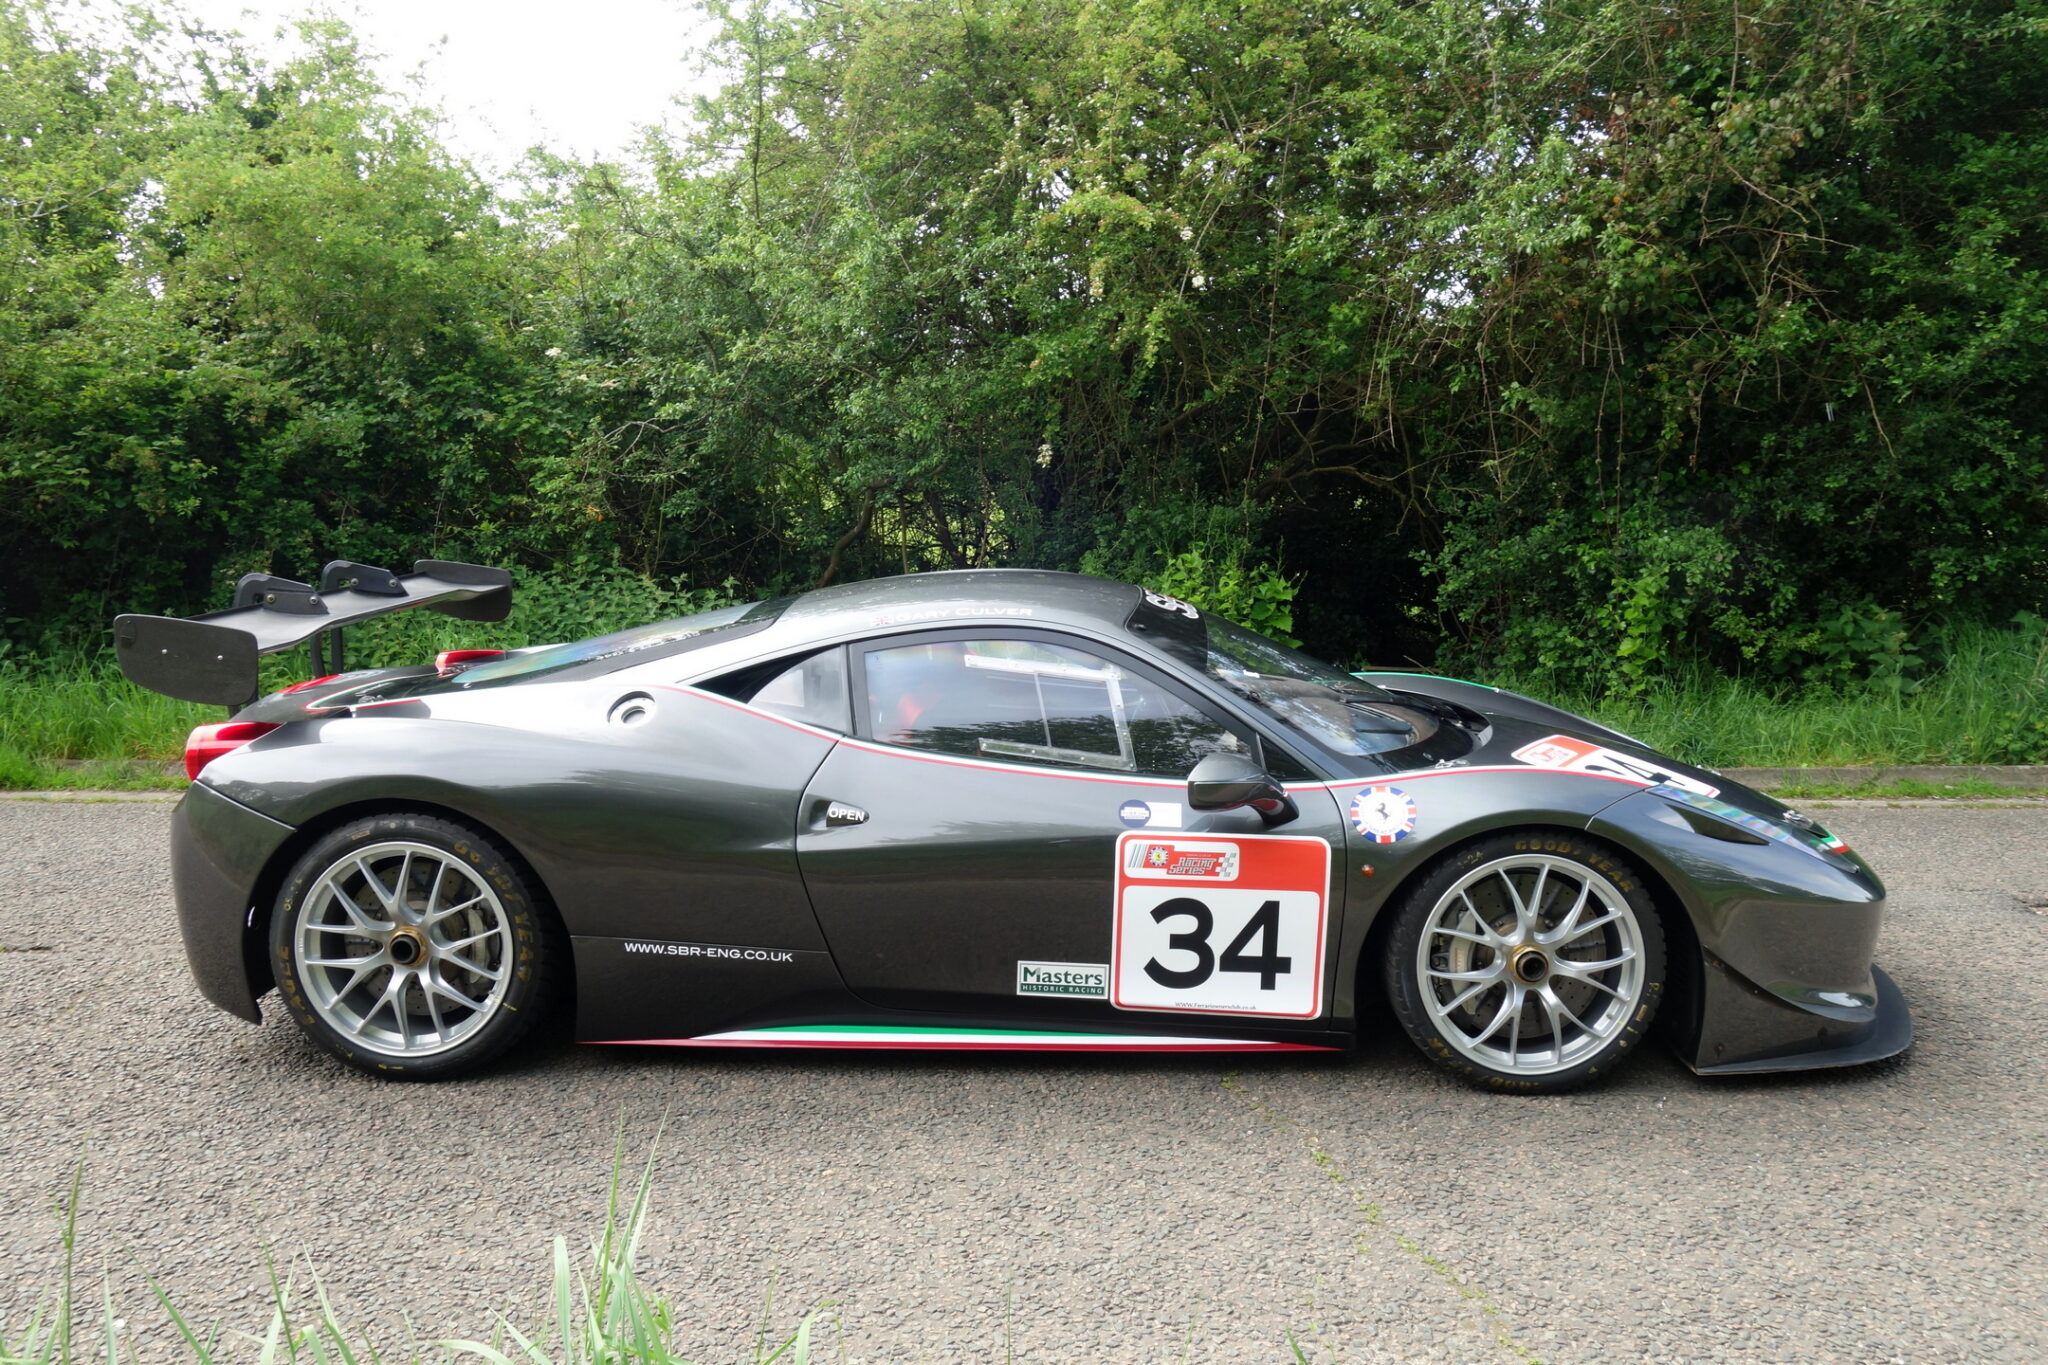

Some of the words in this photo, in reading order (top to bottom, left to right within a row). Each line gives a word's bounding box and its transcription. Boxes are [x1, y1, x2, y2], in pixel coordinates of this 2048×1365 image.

[955, 607, 1033, 617] CULVER
[829, 808, 865, 822] OPEN
[1169, 864, 1206, 875] Series
[1178, 857, 1217, 870] Racing
[1143, 897, 1291, 991] 34
[624, 942, 793, 962] WWW.SBR-ENG.CO.UK
[1023, 966, 1103, 985] Masters
